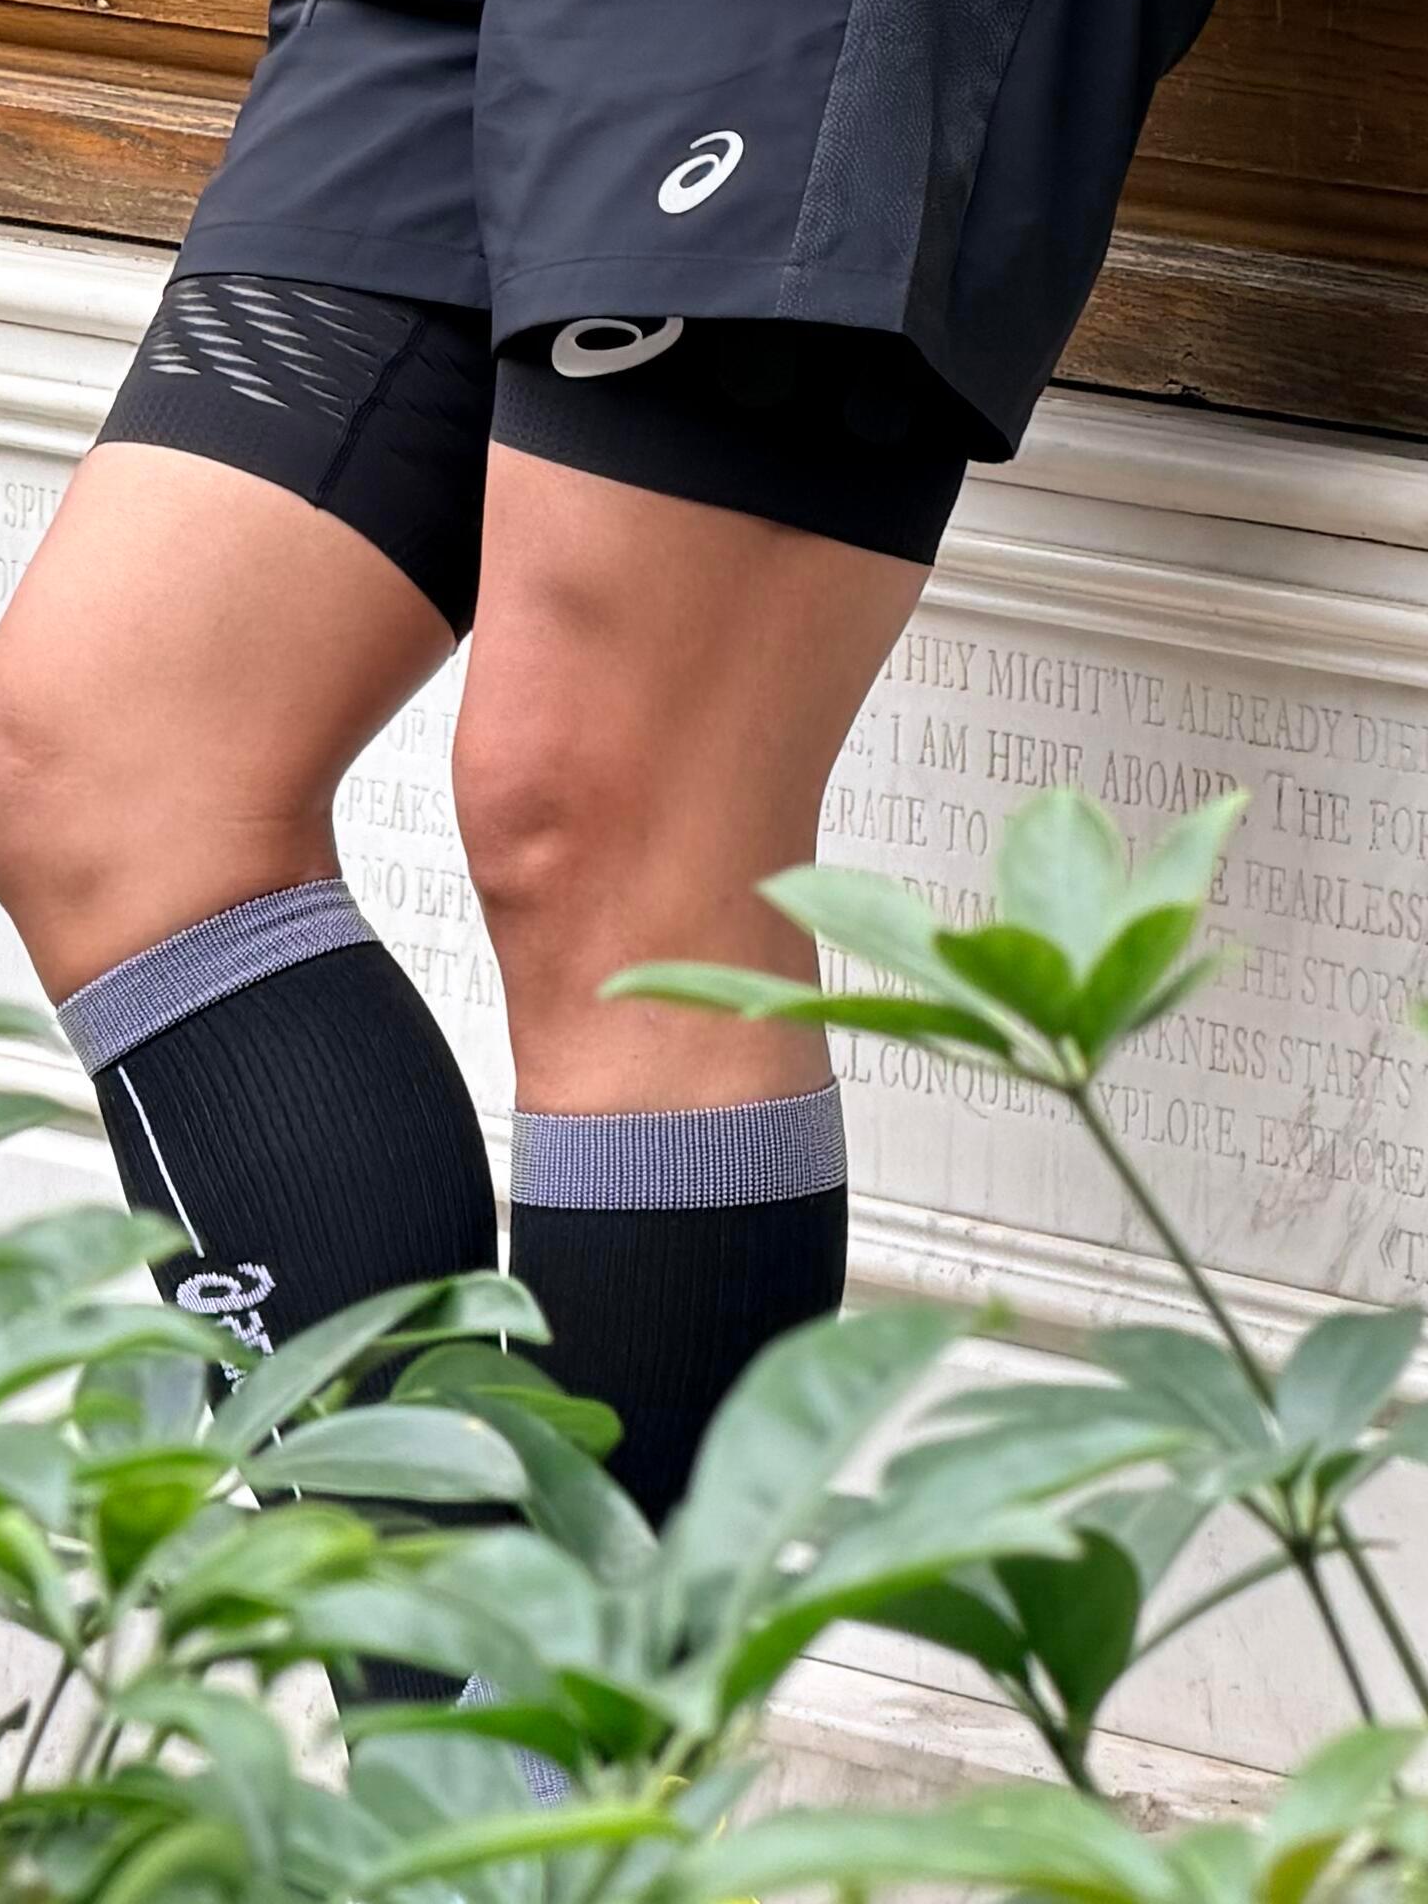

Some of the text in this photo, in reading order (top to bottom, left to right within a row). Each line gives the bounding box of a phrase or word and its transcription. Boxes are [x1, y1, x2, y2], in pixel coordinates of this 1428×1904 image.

[986, 648, 1166, 727] MIGHT'VE
[1176, 680, 1342, 759] ALREADY
[917, 715, 969, 775] AM
[985, 728, 1084, 792] HERE
[1262, 768, 1352, 846] THE
[940, 800, 988, 857] TO
[1277, 1034, 1412, 1110] STARTS
